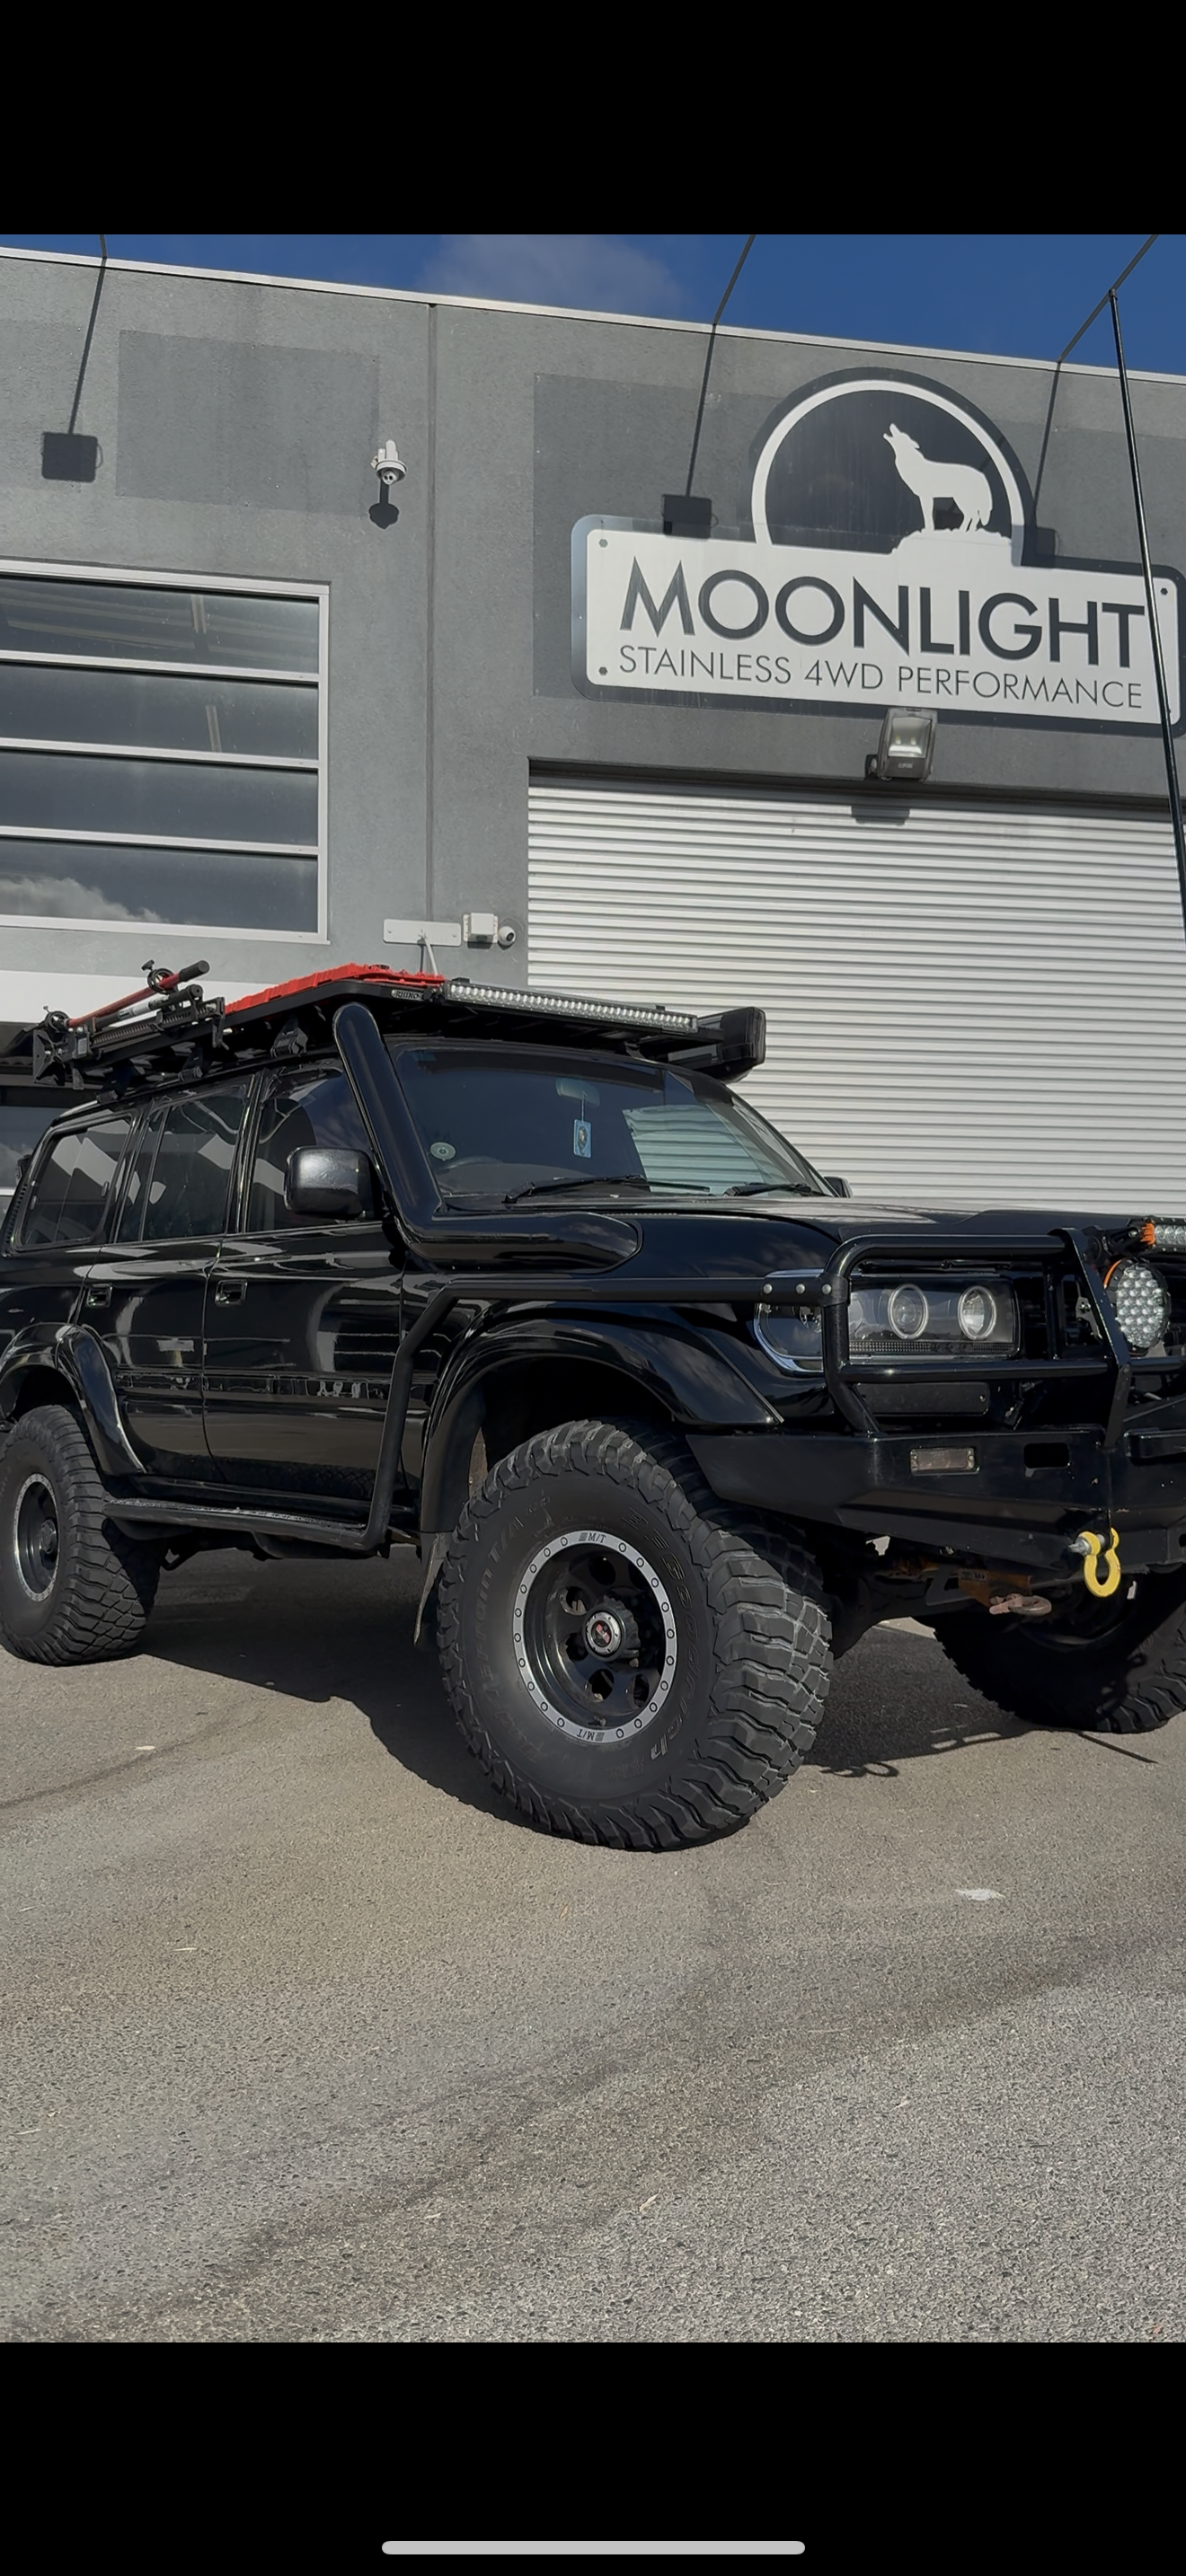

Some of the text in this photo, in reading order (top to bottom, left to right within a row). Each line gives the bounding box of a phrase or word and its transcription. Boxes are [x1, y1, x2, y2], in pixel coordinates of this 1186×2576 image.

[619, 555, 1146, 669] MOONLIGHT
[618, 644, 1143, 710] STAINLESS 4WD PERFORMANCE
